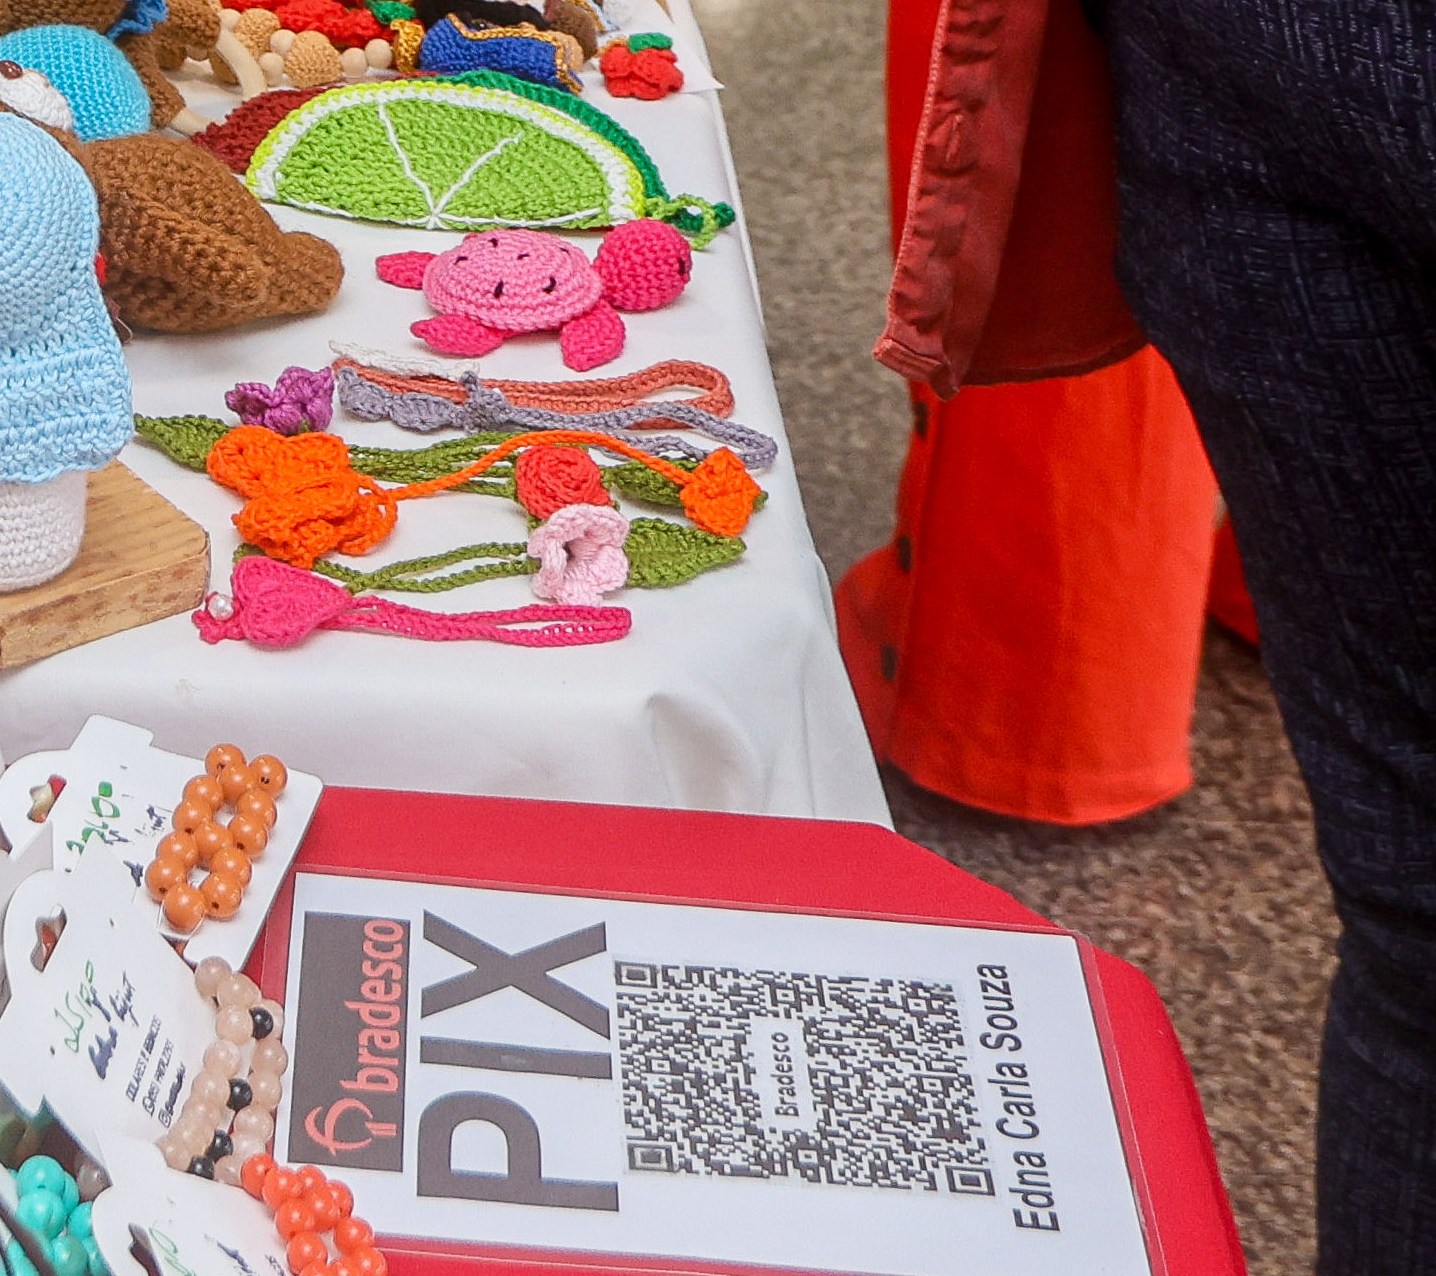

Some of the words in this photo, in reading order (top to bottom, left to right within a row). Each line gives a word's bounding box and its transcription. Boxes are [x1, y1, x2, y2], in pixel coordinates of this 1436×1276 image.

[338, 918, 406, 1093] bradesco
[976, 962, 1023, 1053] Souza
[416, 908, 620, 1213] PIX
[770, 1031, 800, 1118] Bradesco
[987, 1061, 1041, 1140] Carla
[1008, 1150, 1061, 1232] Edna
